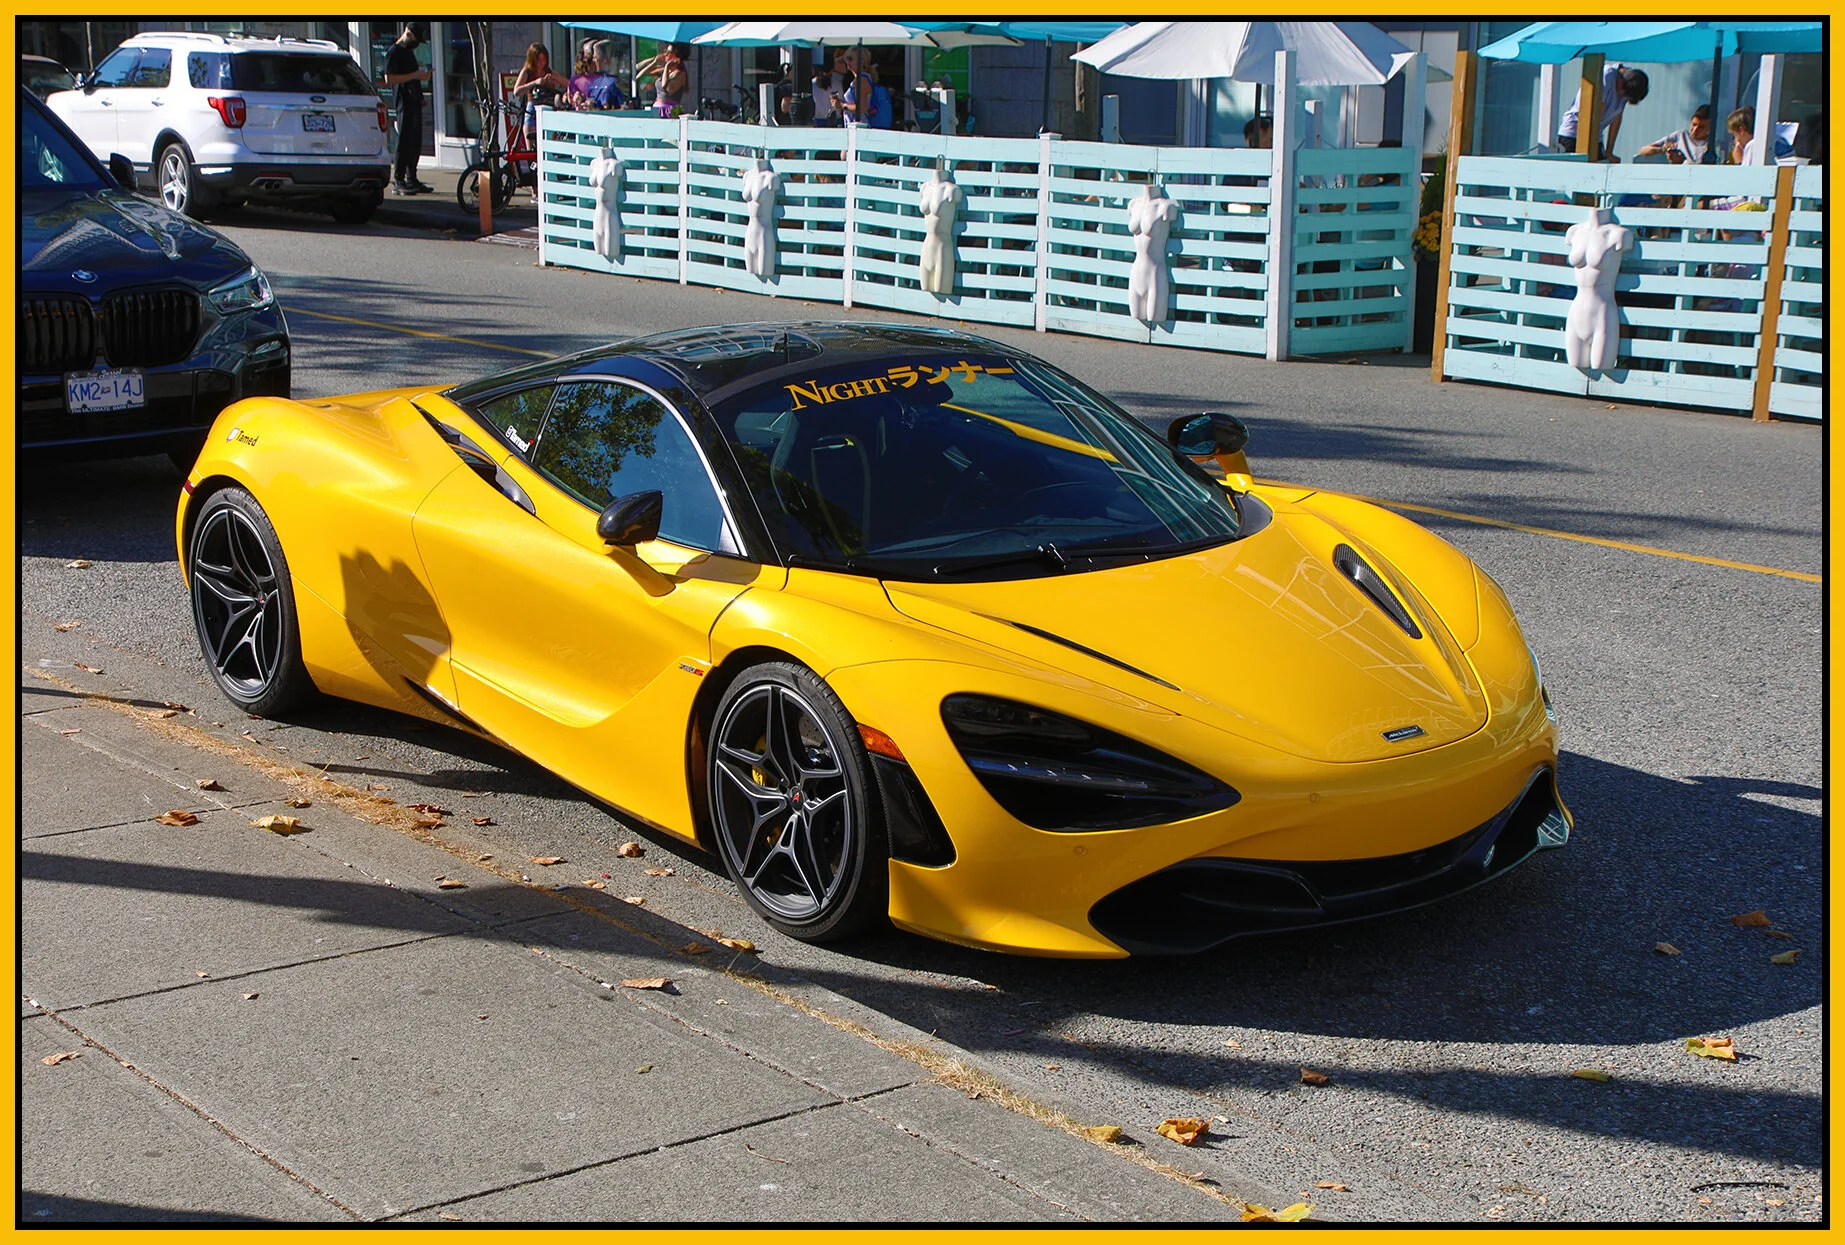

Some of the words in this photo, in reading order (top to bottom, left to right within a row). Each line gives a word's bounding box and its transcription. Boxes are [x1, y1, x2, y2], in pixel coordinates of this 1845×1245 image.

[69, 382, 101, 402] KM2
[114, 379, 142, 398] 14J
[784, 377, 891, 411] NIGHT
[887, 360, 1016, 389] ランナー
